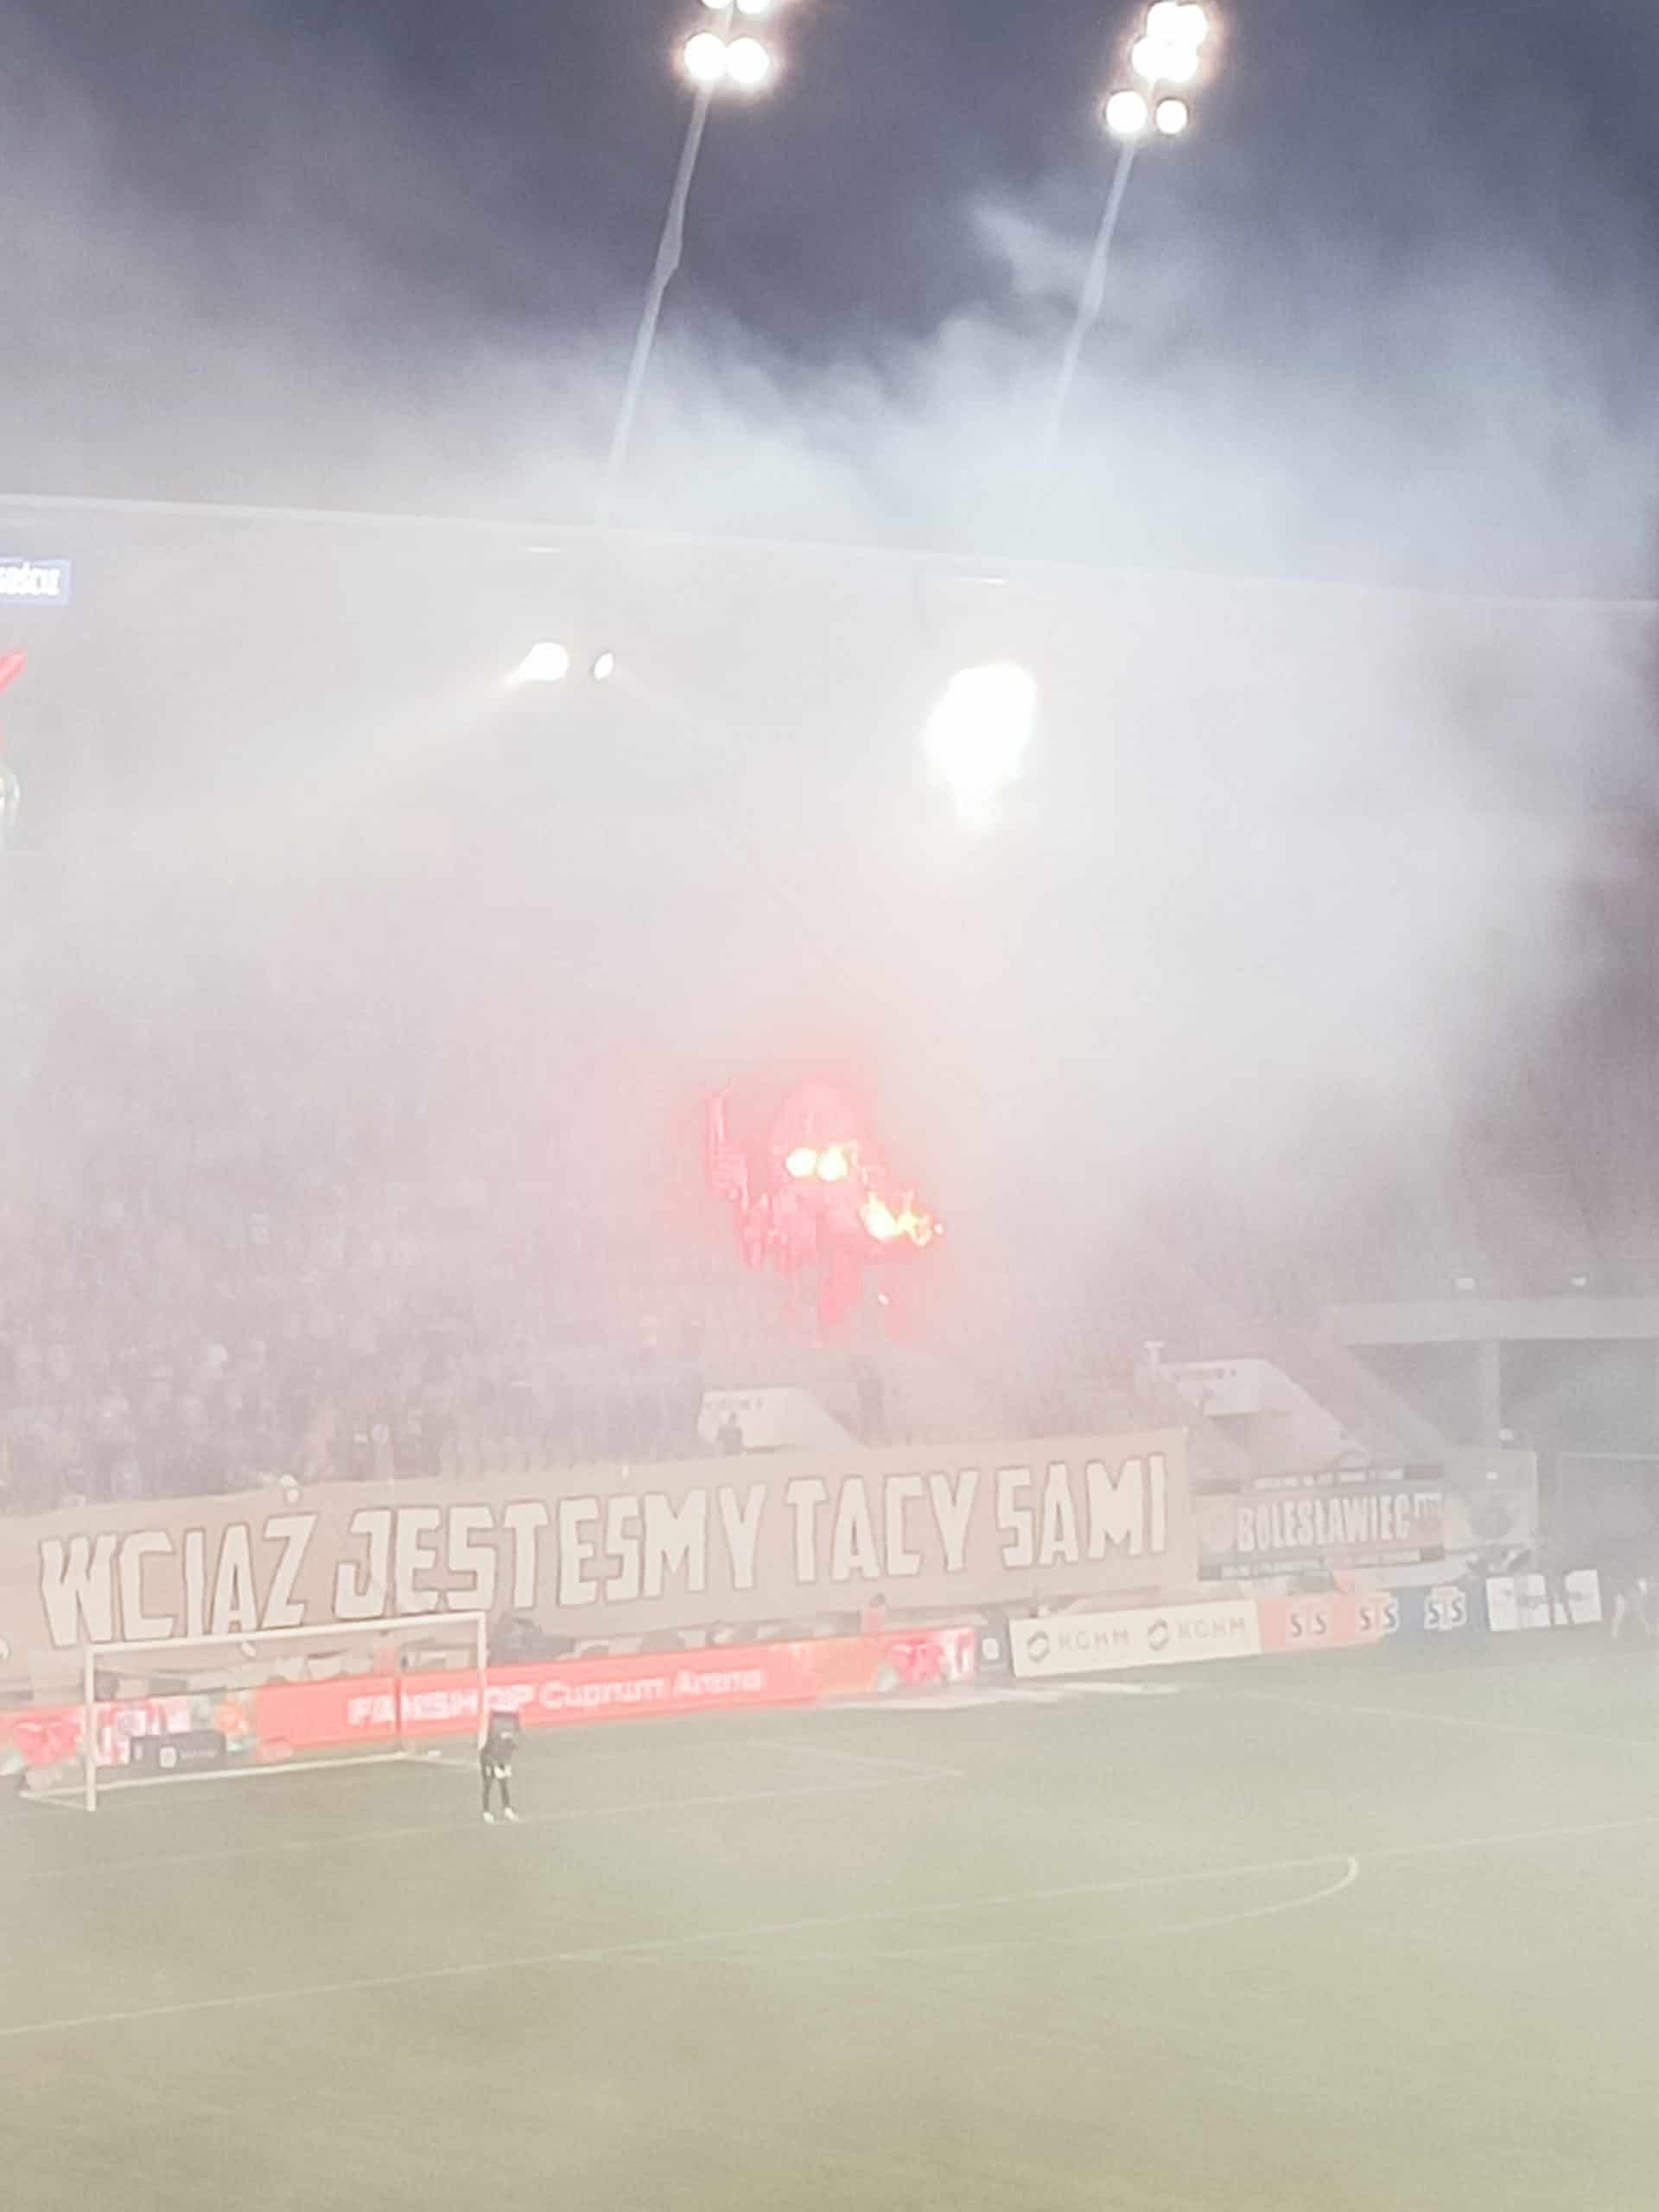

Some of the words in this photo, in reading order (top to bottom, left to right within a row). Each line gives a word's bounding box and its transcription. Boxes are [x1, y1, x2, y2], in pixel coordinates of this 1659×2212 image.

[785, 1468, 982, 1586] TACY
[995, 1451, 1167, 1572] SAMI
[539, 1679, 664, 1713] Cuprum
